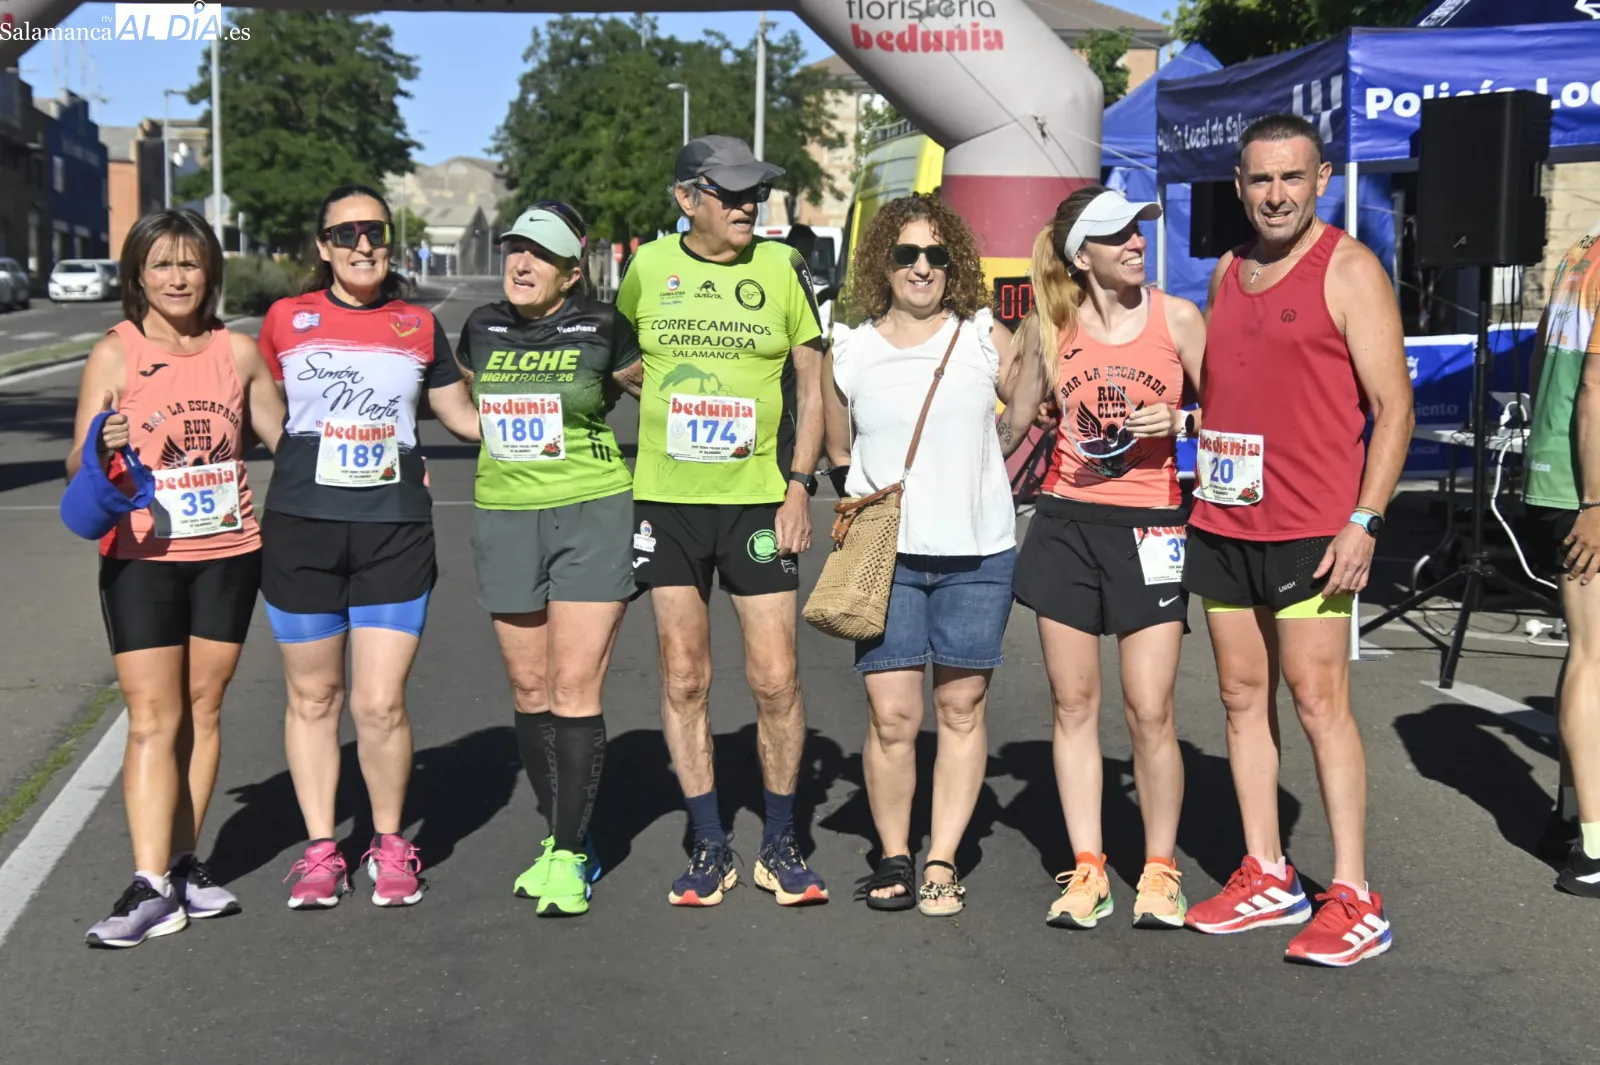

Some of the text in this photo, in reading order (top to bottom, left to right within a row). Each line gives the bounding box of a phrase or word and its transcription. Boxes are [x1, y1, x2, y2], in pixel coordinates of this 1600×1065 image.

[851, 22, 1004, 53] bedunia
[1184, 118, 1210, 150] Local
[1211, 116, 1224, 145] de
[651, 319, 772, 336] CORRECAMINOS
[658, 333, 756, 350] CARBAJOSA
[485, 350, 581, 372] ELCHE
[672, 350, 740, 360] SALAMANCA
[1060, 365, 1168, 399] BAR LA ESCAPADA
[1097, 386, 1127, 402] RUN
[167, 402, 185, 416] LA
[187, 400, 240, 430] ESCAPADA
[481, 398, 560, 415] bedunia
[671, 397, 753, 418] bedunia
[1097, 403, 1127, 419] CLUB
[184, 419, 211, 435] RUN
[324, 422, 396, 441] bedunia
[497, 417, 545, 442] 180
[687, 419, 738, 444] 174
[184, 435, 212, 451] CLUB
[336, 443, 386, 468] 189
[1209, 456, 1235, 485] 20
[180, 489, 216, 517] 35
